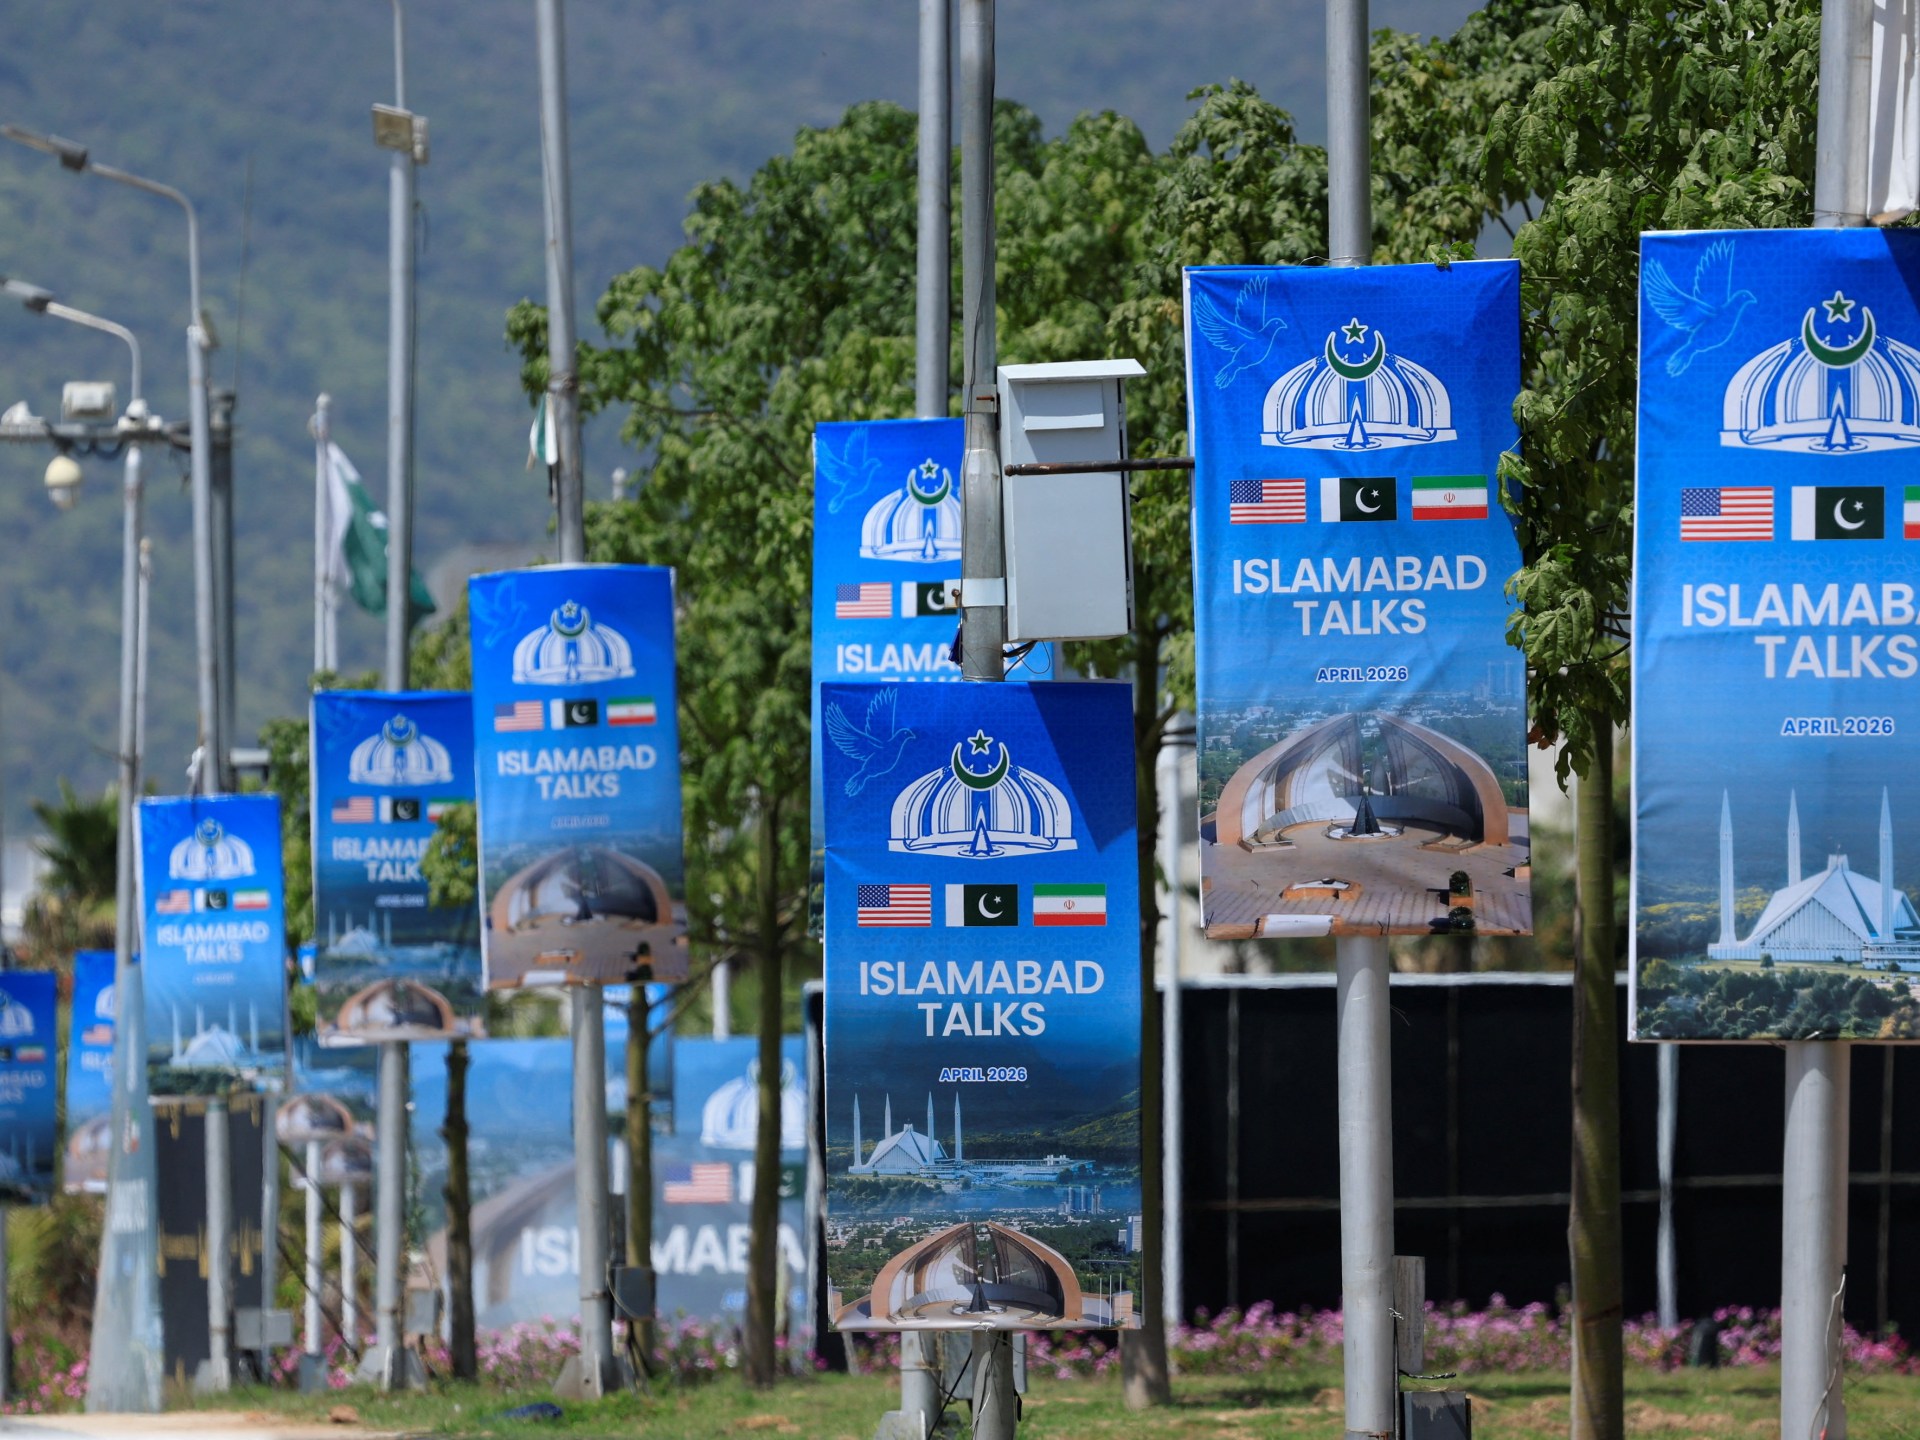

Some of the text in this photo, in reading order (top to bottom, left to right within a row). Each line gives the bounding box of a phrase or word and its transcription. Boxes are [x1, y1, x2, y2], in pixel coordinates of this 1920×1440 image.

[1233, 555, 1487, 594] ISLAMABAD
[1293, 598, 1426, 636] TALKS
[1682, 583, 1920, 627] ISLAMAB
[1754, 634, 1919, 678] TALKS
[1316, 666, 1408, 682] APRIL 2026
[1781, 716, 1895, 736] APRIL 2026
[497, 744, 657, 776] ISLAMABAD
[536, 773, 620, 799] TALKS
[364, 860, 427, 882] TALK
[157, 921, 270, 946] ISLAMABAD
[184, 941, 244, 964] TALKS
[859, 960, 1105, 995] ISLAMABAD
[917, 1002, 1046, 1037] TALKS
[939, 1066, 1027, 1082] APRIL 2026
